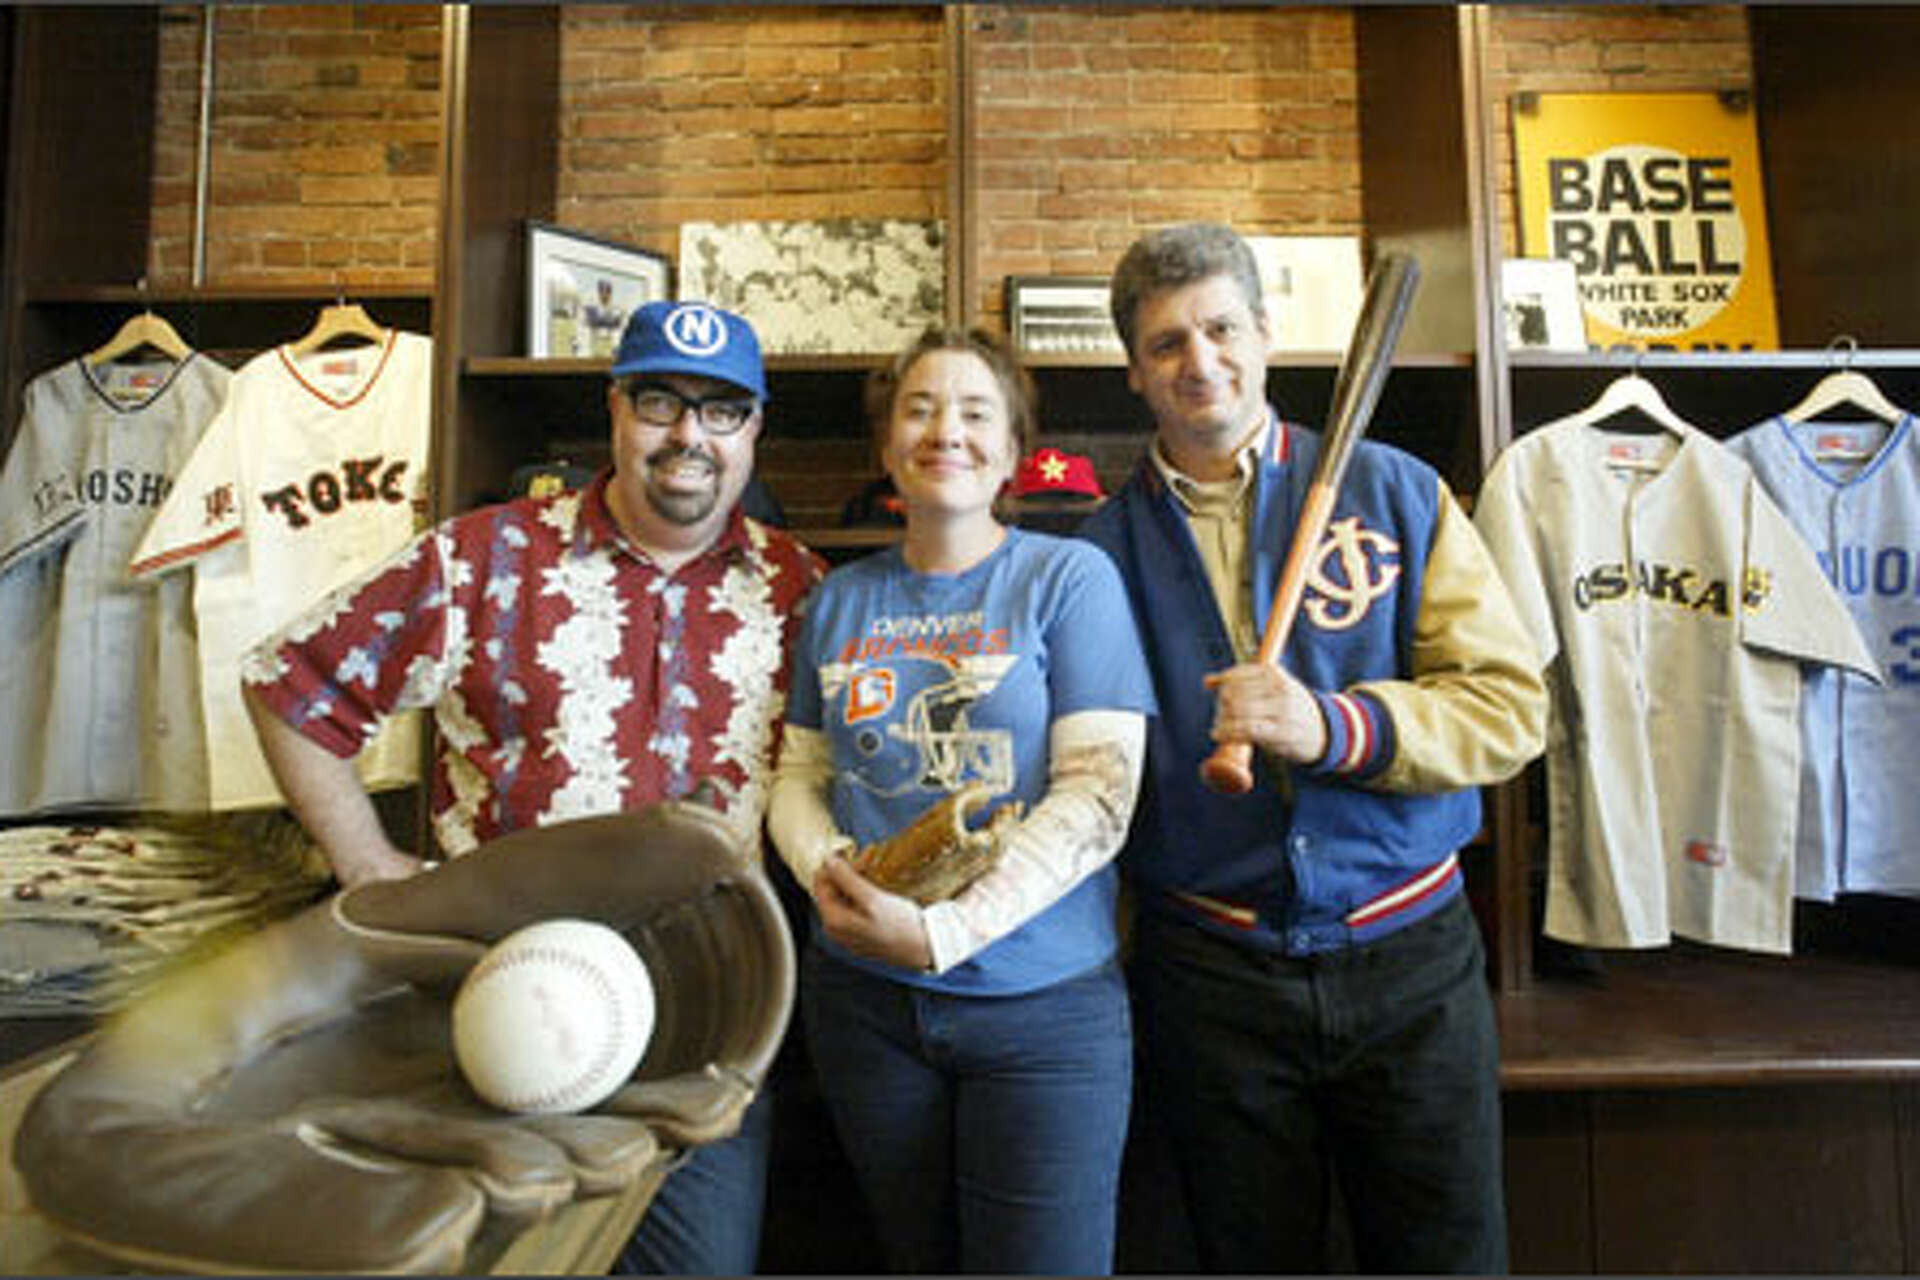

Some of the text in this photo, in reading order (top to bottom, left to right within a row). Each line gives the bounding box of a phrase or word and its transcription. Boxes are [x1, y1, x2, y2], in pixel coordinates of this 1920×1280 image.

[1549, 158, 1734, 213] BASE
[1552, 219, 1741, 276] BALL
[1579, 282, 1731, 302] WHITE SOX
[1620, 307, 1689, 329] PARK
